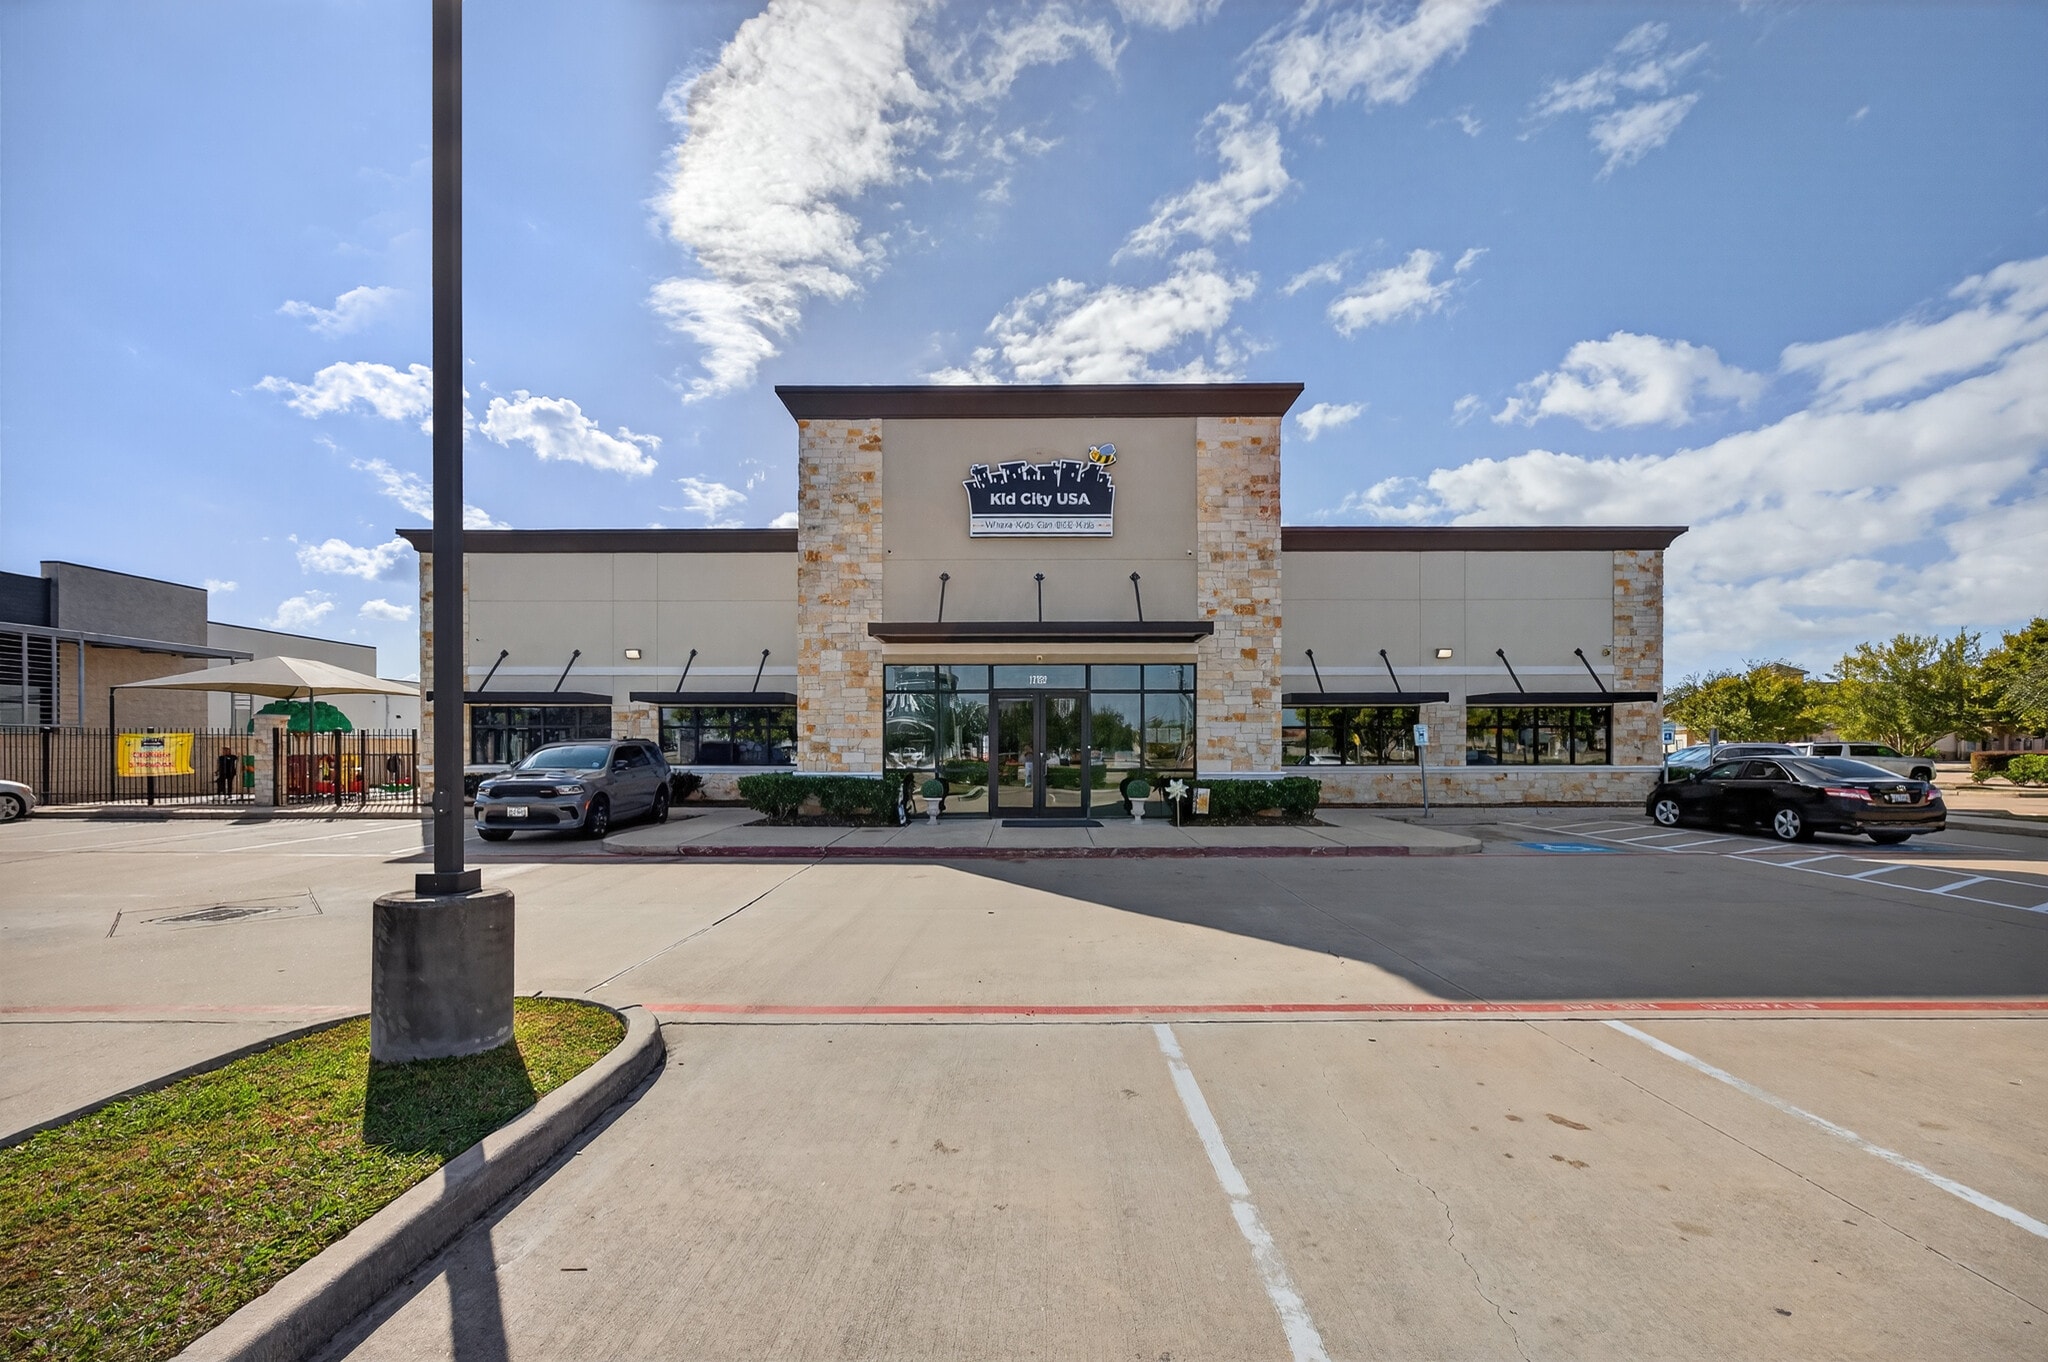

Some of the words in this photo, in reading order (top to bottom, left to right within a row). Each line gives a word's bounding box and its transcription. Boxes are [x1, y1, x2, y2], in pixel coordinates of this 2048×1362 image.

[990, 492, 1016, 506] Kid
[1020, 492, 1052, 507] City
[1057, 492, 1091, 506] USA
